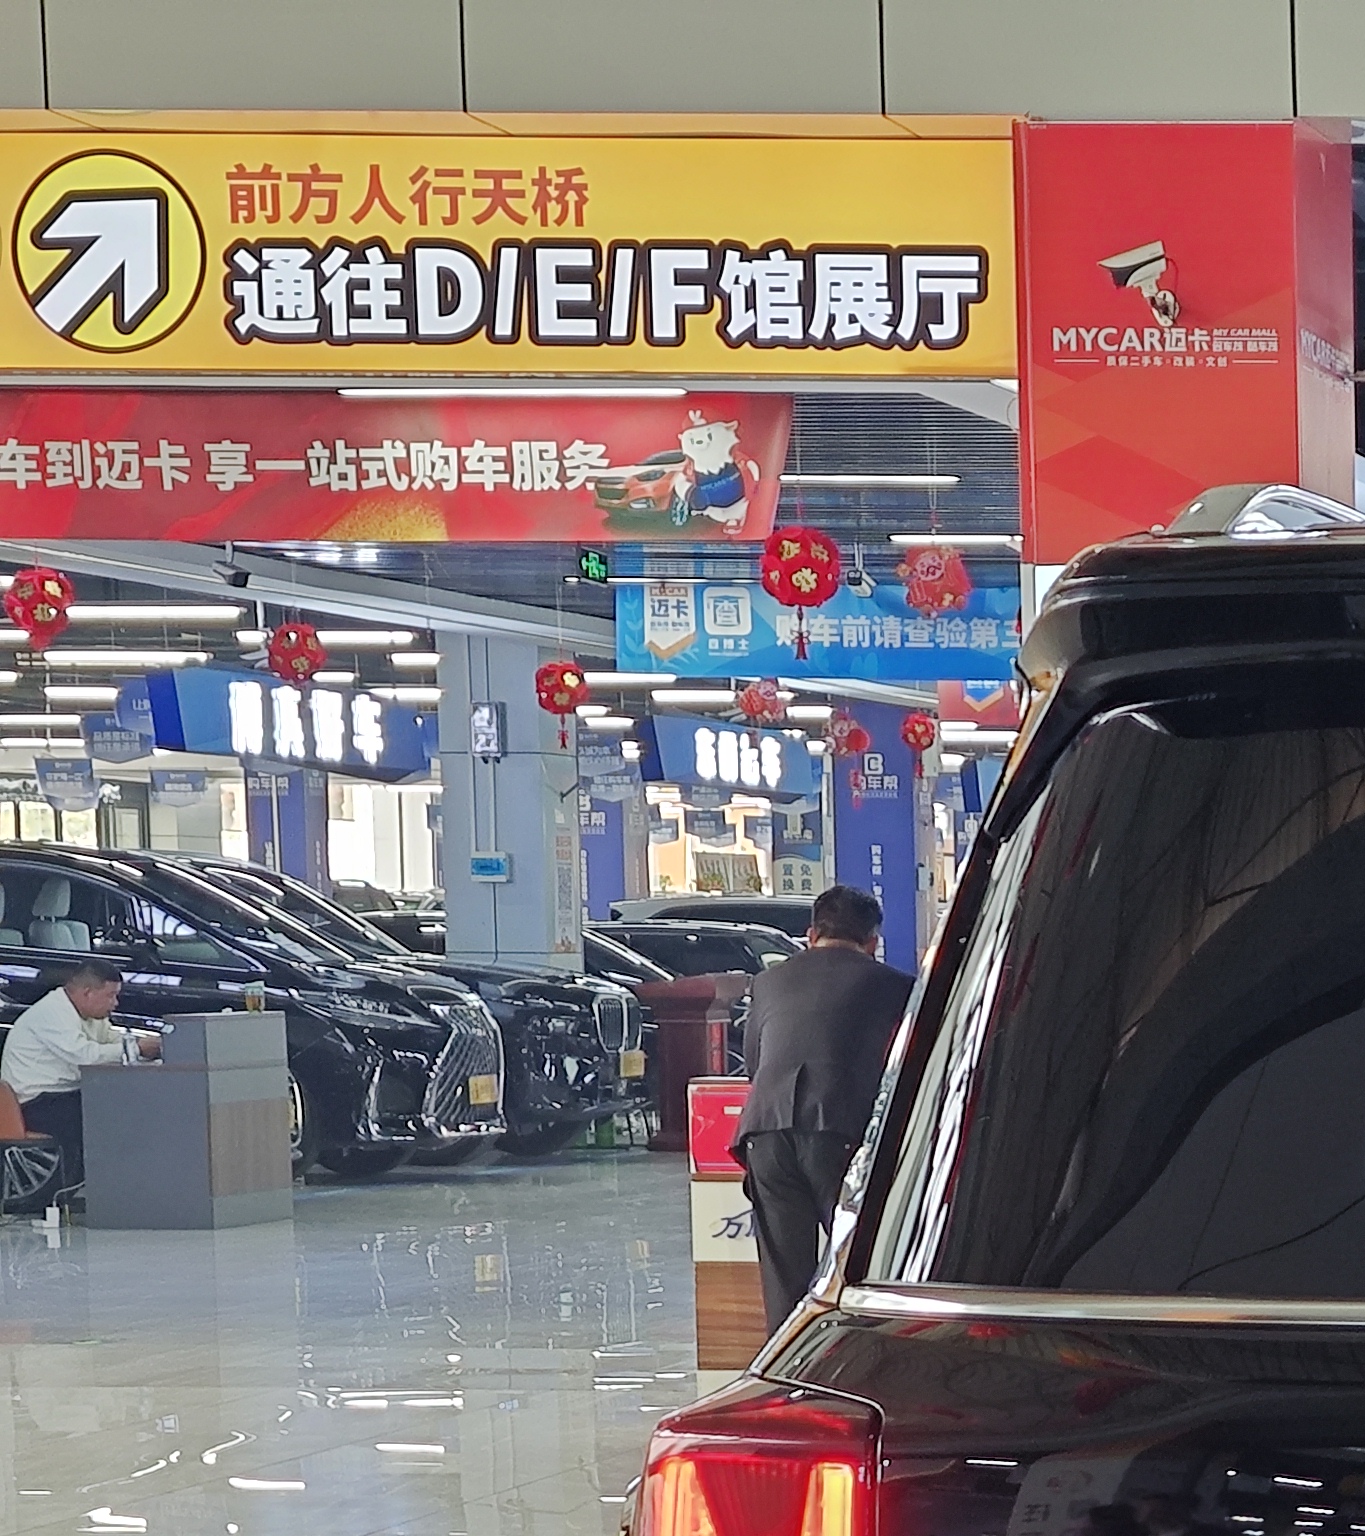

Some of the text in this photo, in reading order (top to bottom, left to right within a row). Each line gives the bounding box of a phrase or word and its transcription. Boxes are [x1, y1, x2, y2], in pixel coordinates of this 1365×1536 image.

[226, 163, 590, 228] 前方人行天桥
[231, 244, 981, 343] 通往D/E/F馆展厅
[1052, 327, 1211, 353] MYCAR迈卡
[0, 438, 611, 491] 车到迈卡 享一站式购车服务
[650, 598, 689, 619] 迈卡
